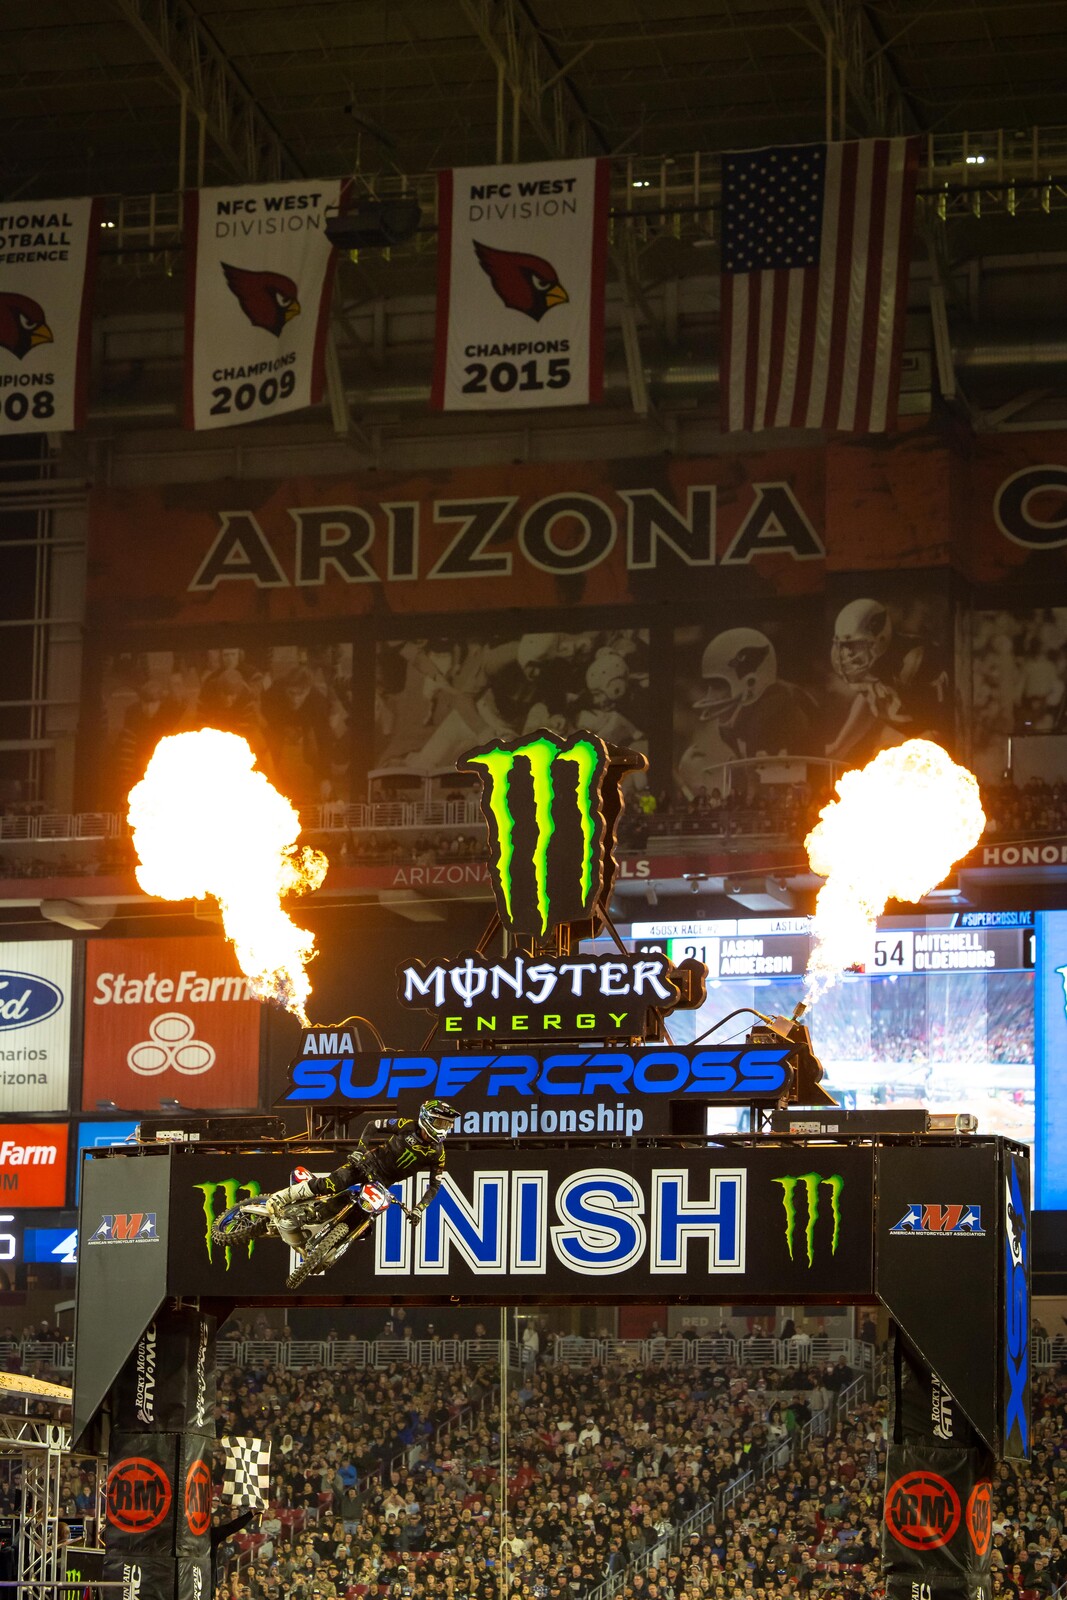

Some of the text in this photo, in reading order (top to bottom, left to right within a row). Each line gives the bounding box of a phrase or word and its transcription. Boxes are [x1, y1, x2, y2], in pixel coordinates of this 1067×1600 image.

[470, 178, 577, 200] NFC WEST
[217, 193, 322, 216] NFC WEST
[469, 198, 577, 222] DIVISION
[215, 214, 320, 238] DIVISION
[464, 339, 570, 358] CHAMPIONS
[212, 352, 297, 382] CHAMPIONS
[462, 358, 571, 394] 2015
[210, 369, 296, 416] 2009
[187, 481, 827, 592] ARIZONA
[721, 939, 764, 957] JASON
[874, 940, 904, 967] 54
[914, 933, 982, 952] MITCHELL
[721, 956, 792, 975] ANDERSON
[914, 950, 996, 969] OLDENBURG
[403, 957, 671, 1008] MONSTER
[445, 1012, 628, 1032] ENERGY
[302, 1032, 354, 1055] AMA
[285, 1050, 791, 1100] SUPERCROSS
[87, 1212, 160, 1241] AMA
[888, 1204, 986, 1232] AMA
[135, 1374, 145, 1408] ROCKY
[931, 1387, 941, 1423] ROCKY
